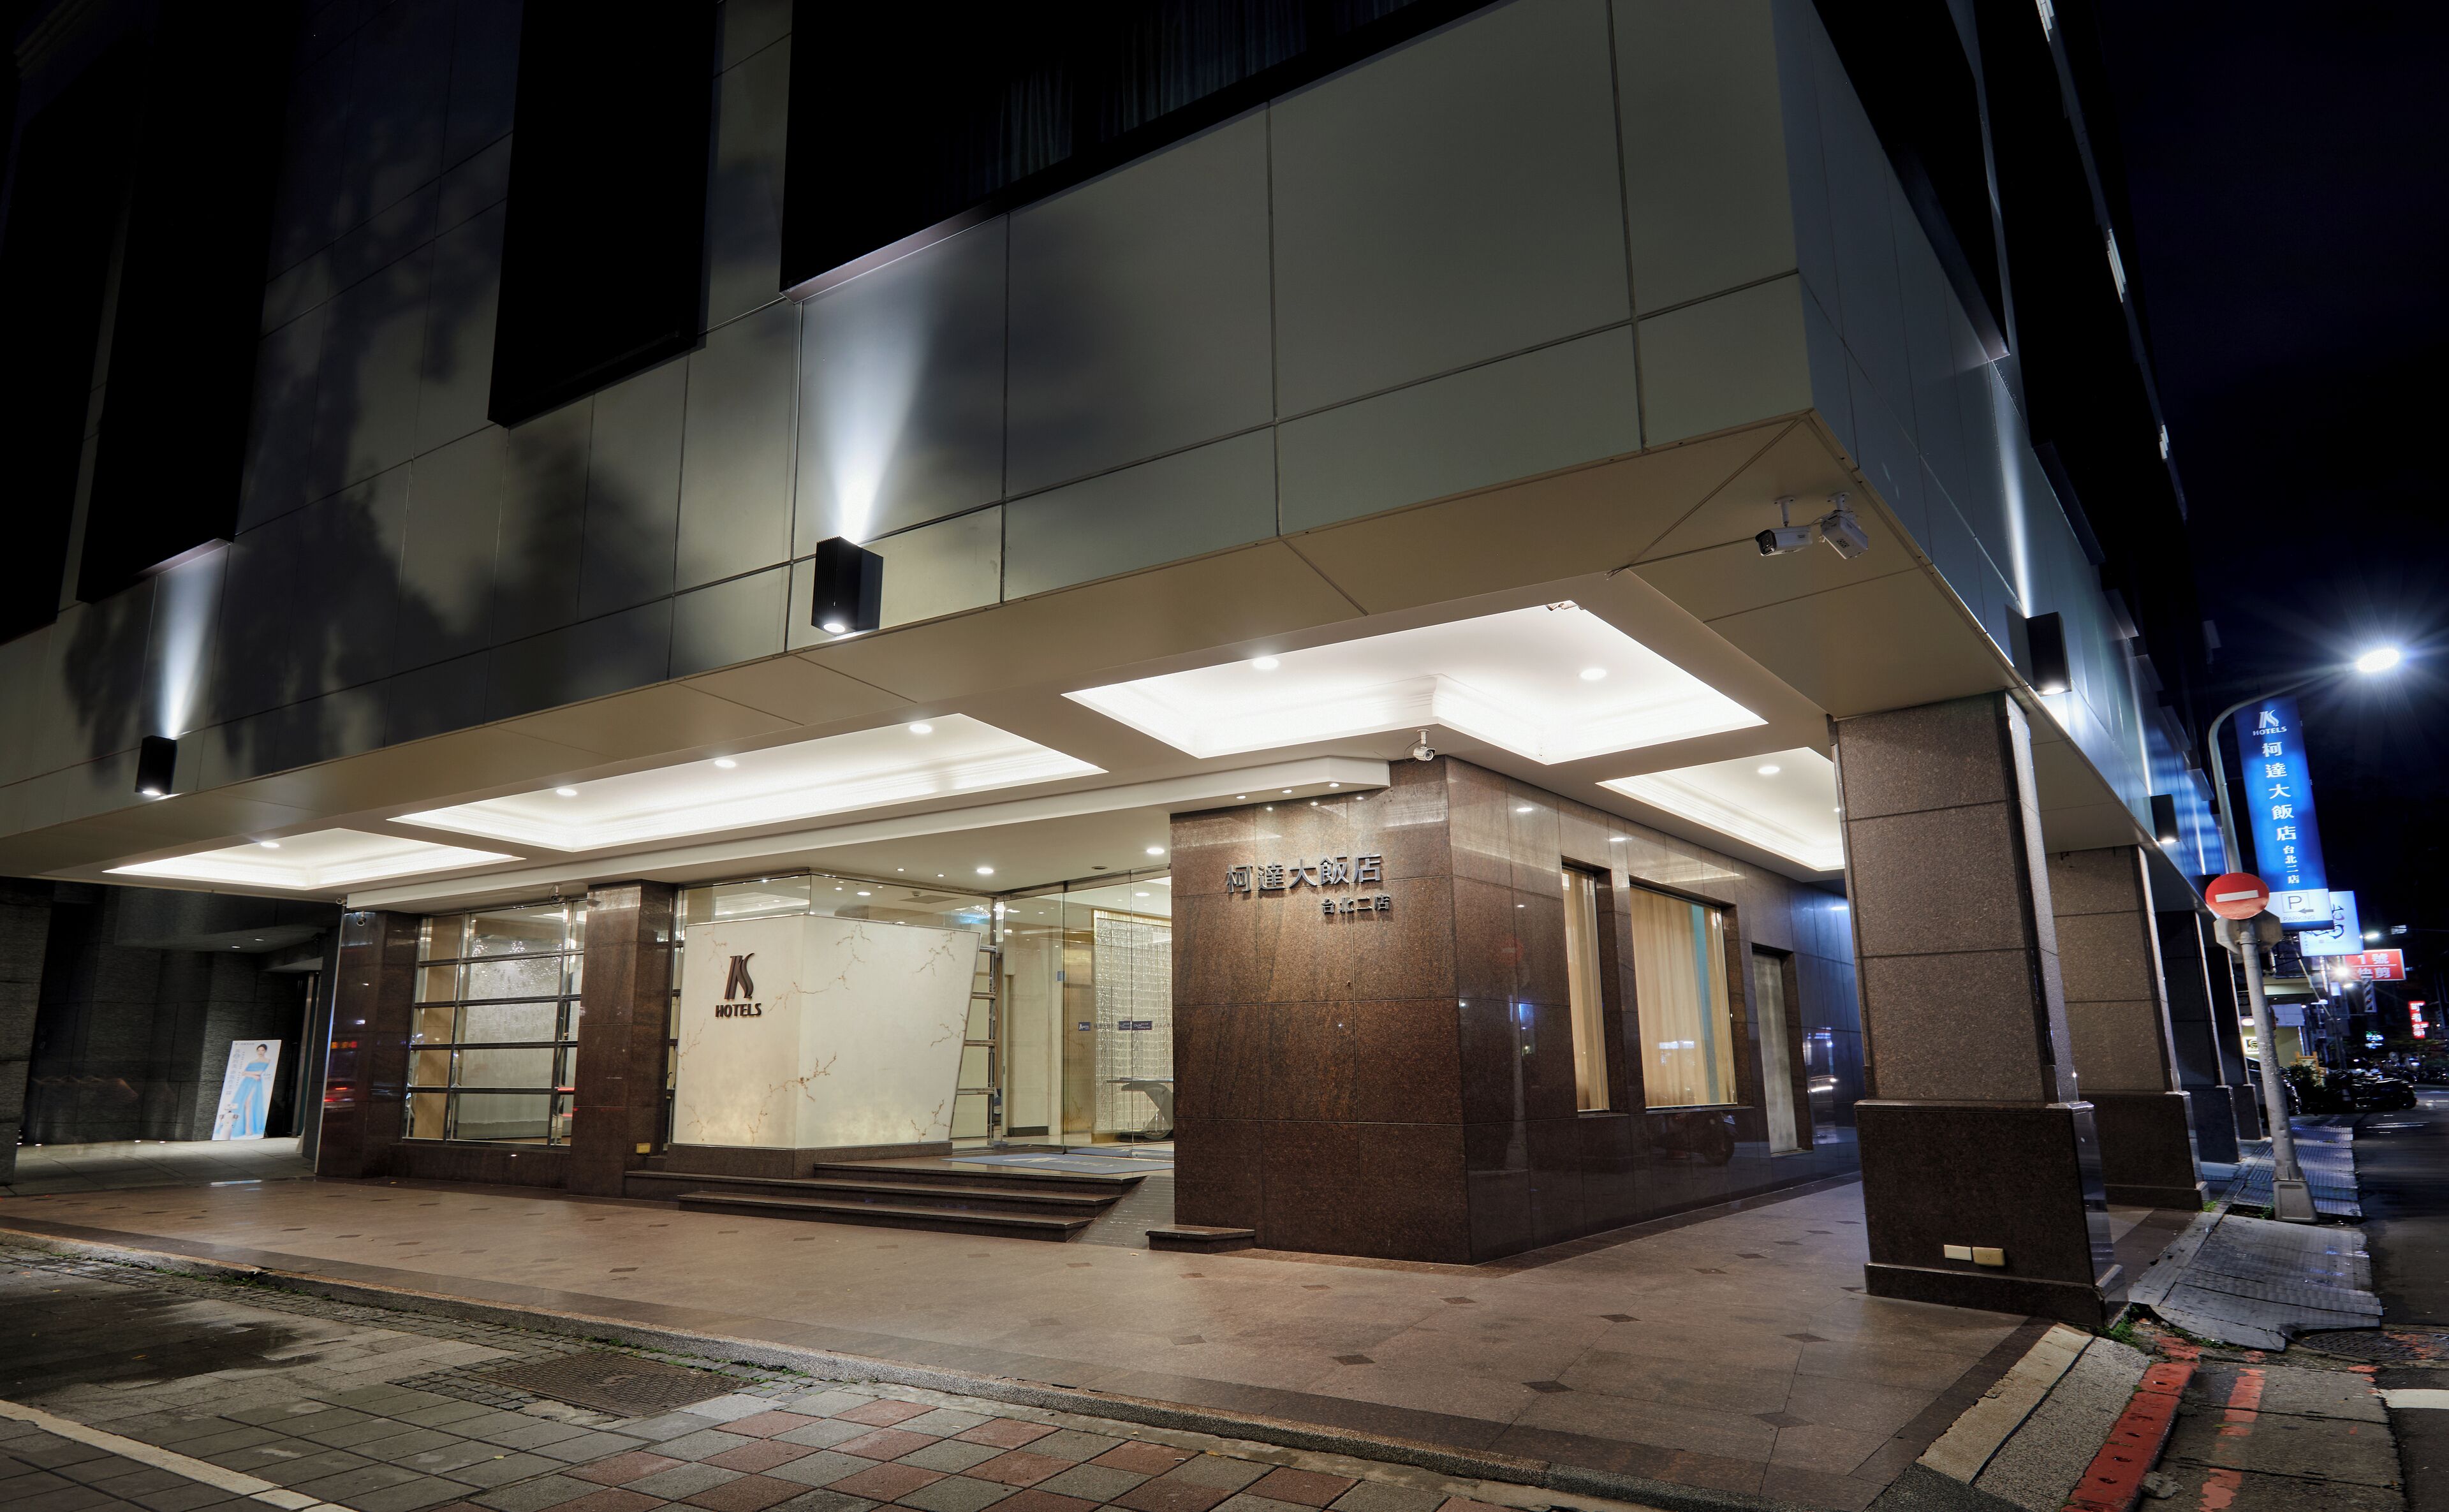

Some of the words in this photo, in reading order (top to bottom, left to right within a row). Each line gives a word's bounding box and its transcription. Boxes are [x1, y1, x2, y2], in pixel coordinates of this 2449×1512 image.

[2252, 726, 2288, 736] HOTELS
[2261, 742, 2297, 841] 柯達大飯店
[1226, 853, 1382, 893] 柯達大飯店
[2283, 845, 2300, 884] 台北二店
[1321, 893, 1390, 914] 台北二店
[2288, 896, 2302, 909] P
[715, 1003, 762, 1018] HOTELS
